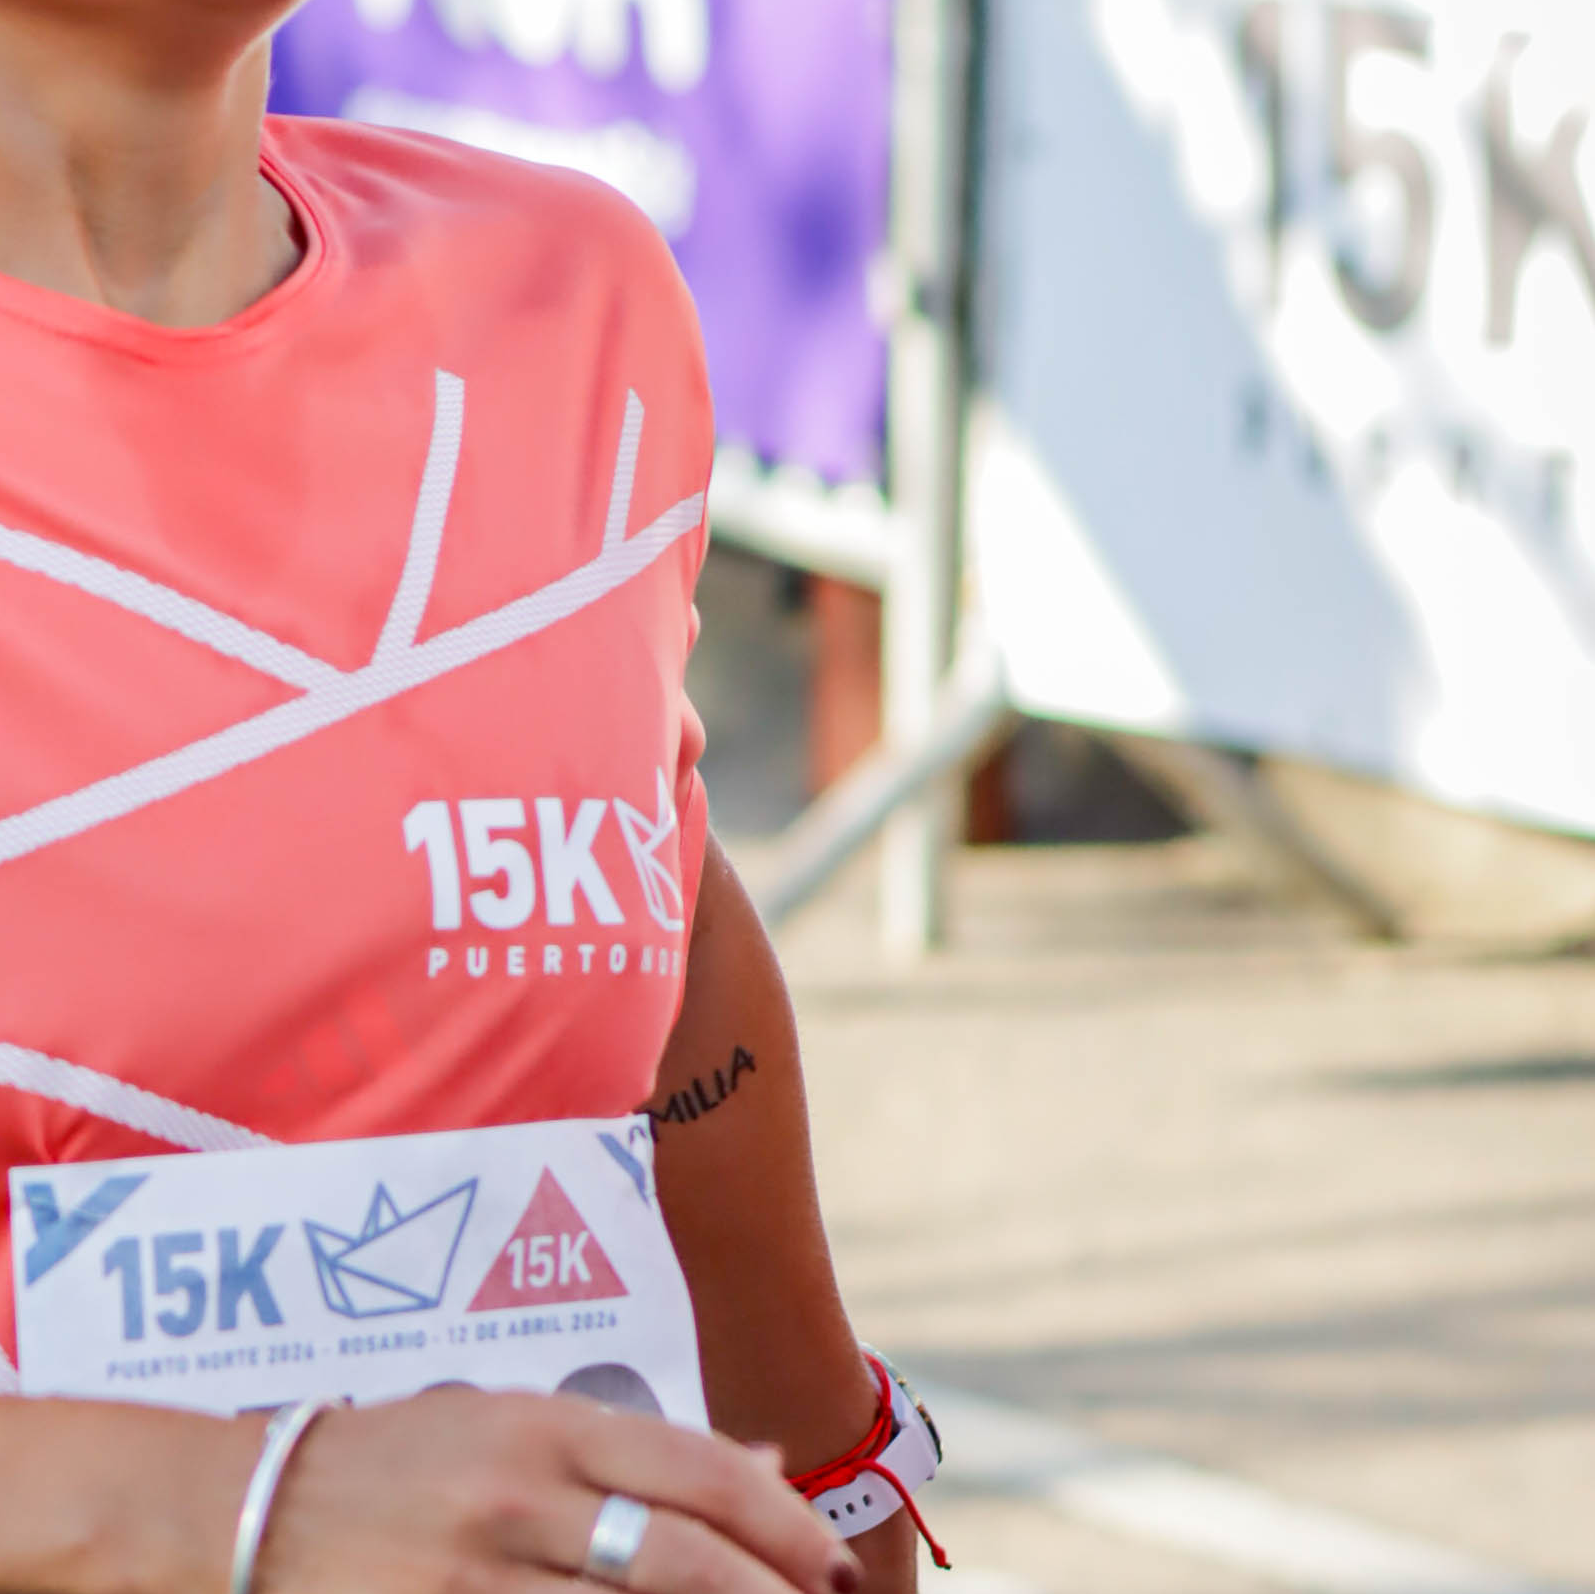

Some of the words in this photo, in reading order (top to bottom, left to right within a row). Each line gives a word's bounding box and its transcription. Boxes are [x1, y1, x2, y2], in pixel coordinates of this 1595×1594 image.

[403, 796, 626, 930] 15K
[428, 943, 627, 978] PUERTO
[102, 1224, 286, 1343] 15K
[506, 1230, 592, 1290] 15K
[107, 1355, 188, 1379] PUERTO
[197, 1346, 258, 1371] NORTE
[339, 1330, 427, 1355] ROSARIO
[448, 1324, 467, 1345] 12
[476, 1321, 498, 1341] DE
[507, 1314, 563, 1338] ABRIL
